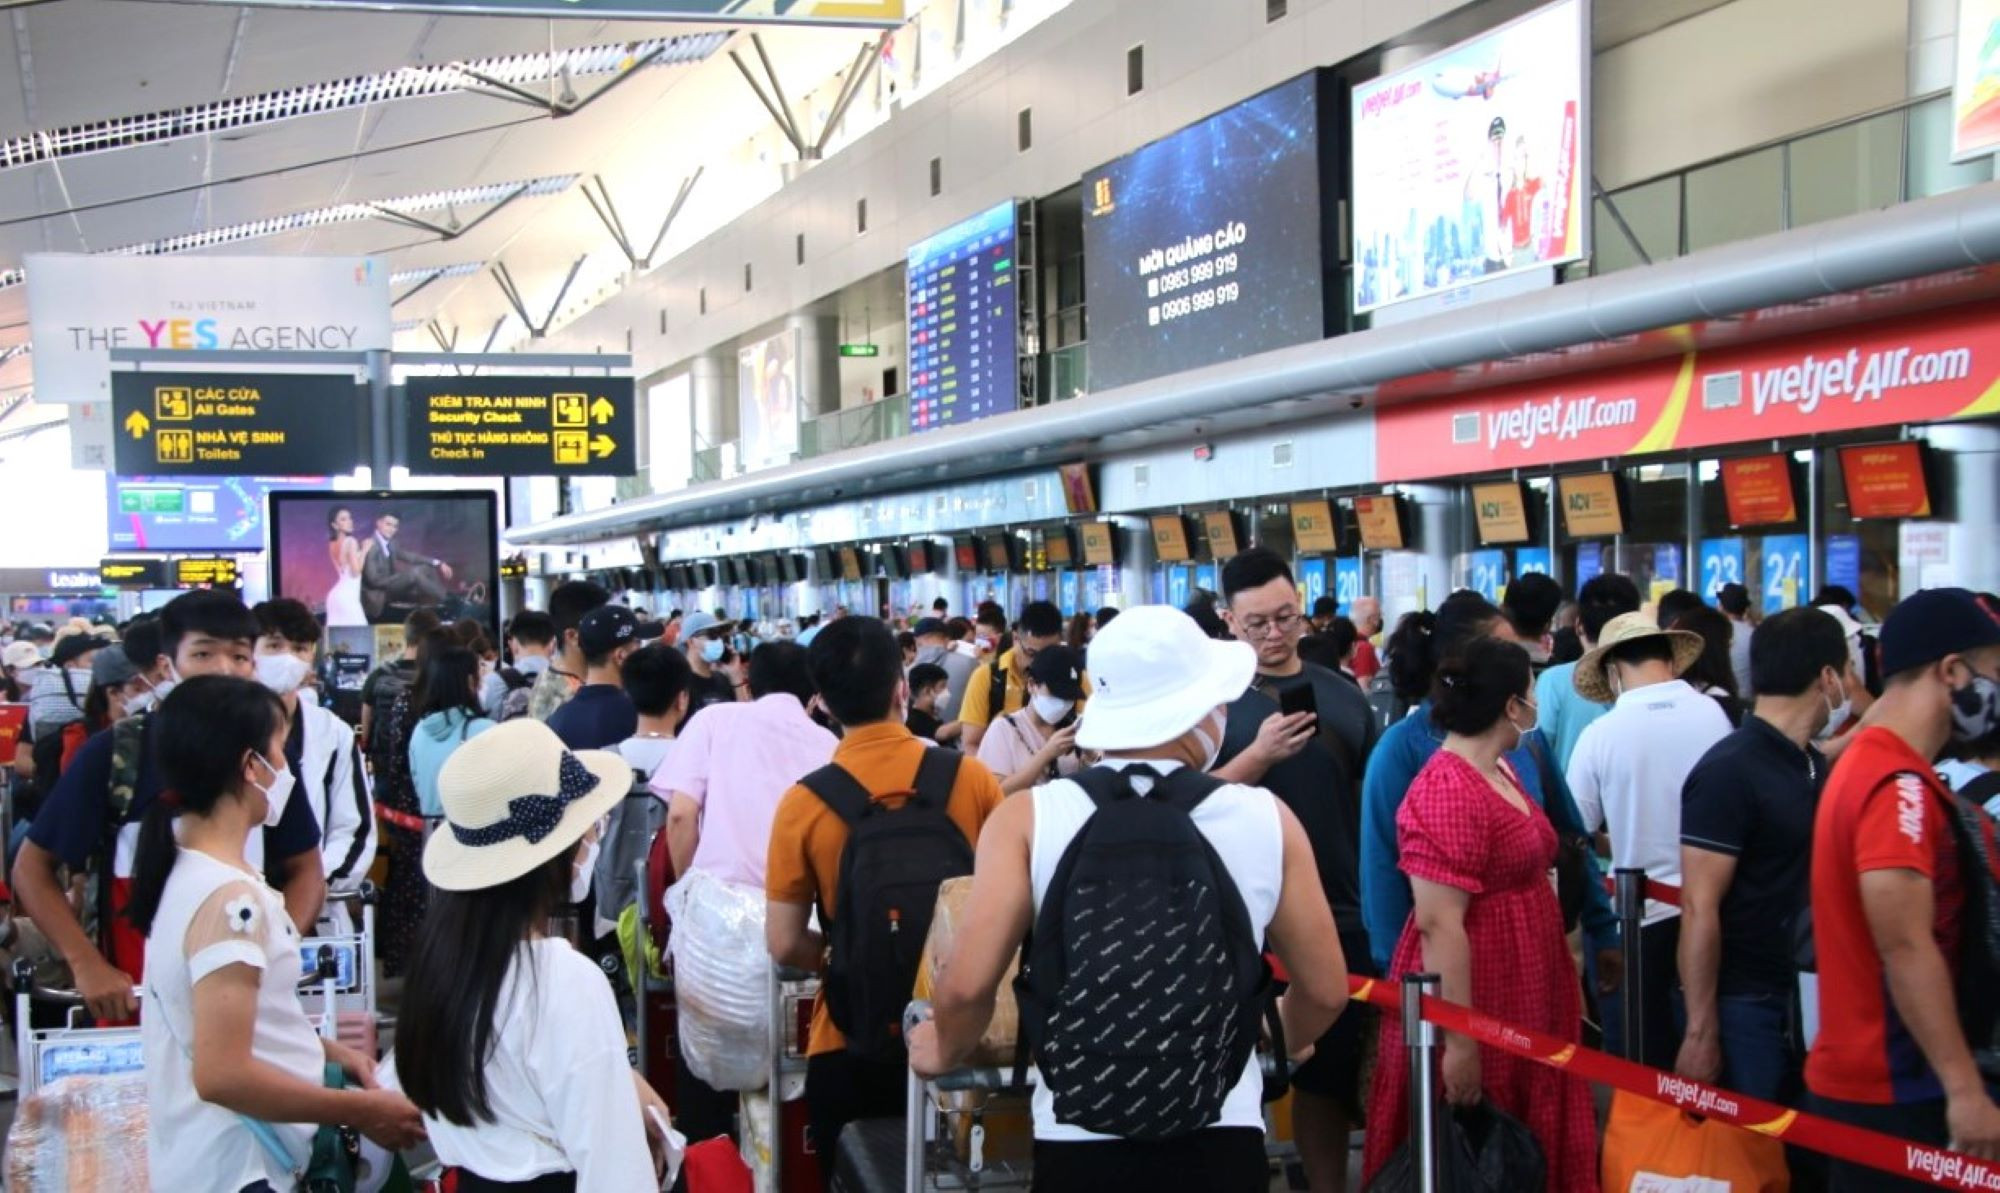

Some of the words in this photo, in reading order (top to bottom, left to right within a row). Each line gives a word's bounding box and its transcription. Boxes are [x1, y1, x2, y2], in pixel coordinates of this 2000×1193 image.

[1165, 235, 1213, 267] QUẢNG
[1215, 221, 1246, 250] CÁO
[1190, 260, 1214, 284] 999
[1215, 252, 1238, 276] 919
[170, 300, 193, 311] TAJ
[197, 300, 257, 311] VIETNAM
[1161, 296, 1191, 320] 0906
[1192, 289, 1215, 312] 999
[1216, 281, 1239, 305] 919
[67, 326, 128, 351] THE
[138, 319, 219, 350] YES
[230, 325, 358, 351] AGENCY
[195, 386, 225, 400] CÁC
[464, 396, 492, 408] TRA
[493, 396, 512, 408] AN
[515, 396, 547, 408] NINH
[195, 403, 214, 416] All
[217, 403, 256, 416] Gates
[429, 411, 480, 425] Security
[483, 411, 522, 423] Check
[196, 429, 227, 443] NHÀ
[251, 431, 285, 443] SINH
[478, 430, 509, 443] HÀNG
[510, 430, 549, 443] KHÔNG
[197, 448, 241, 460] Toilets
[431, 447, 469, 459] Check
[472, 447, 485, 459] in
[1477, 563, 1497, 601] 21
[1706, 554, 1742, 598] 23
[1305, 571, 1323, 605] 19
[1337, 571, 1358, 604] 20
